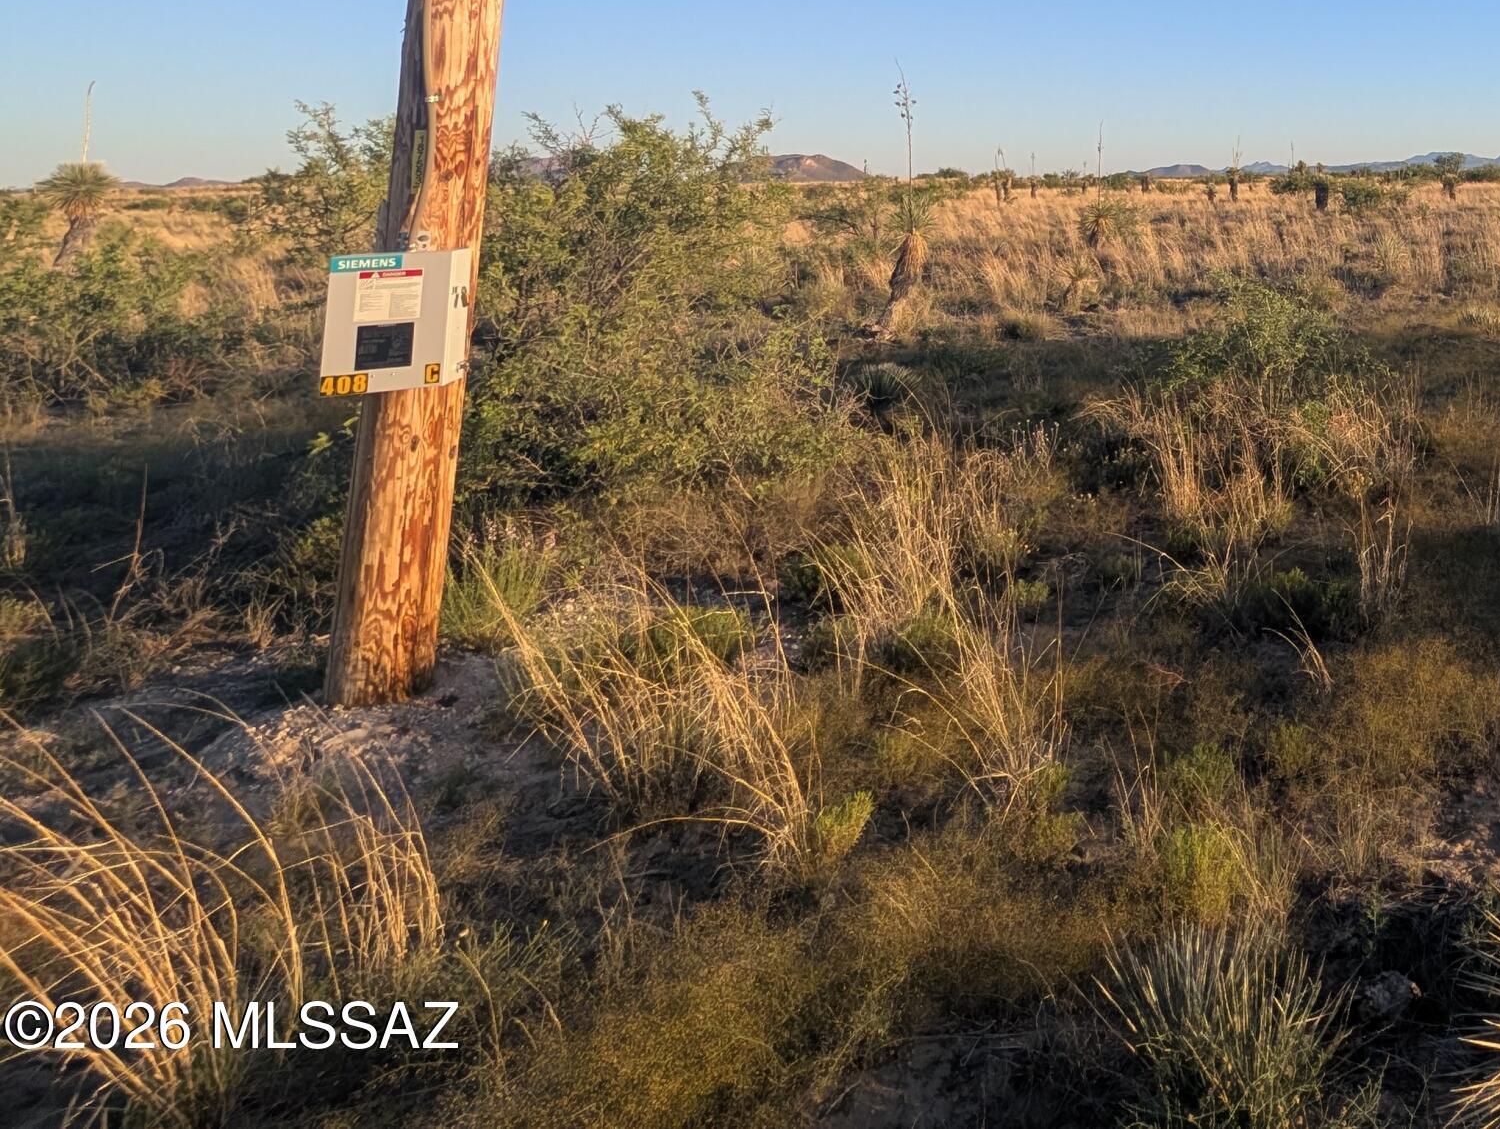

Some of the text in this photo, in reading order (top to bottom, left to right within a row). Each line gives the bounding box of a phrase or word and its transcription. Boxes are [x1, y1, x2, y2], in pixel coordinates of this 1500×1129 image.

[337, 257, 397, 270] SIEMENS
[426, 365, 439, 382] C
[320, 374, 368, 396] 408
